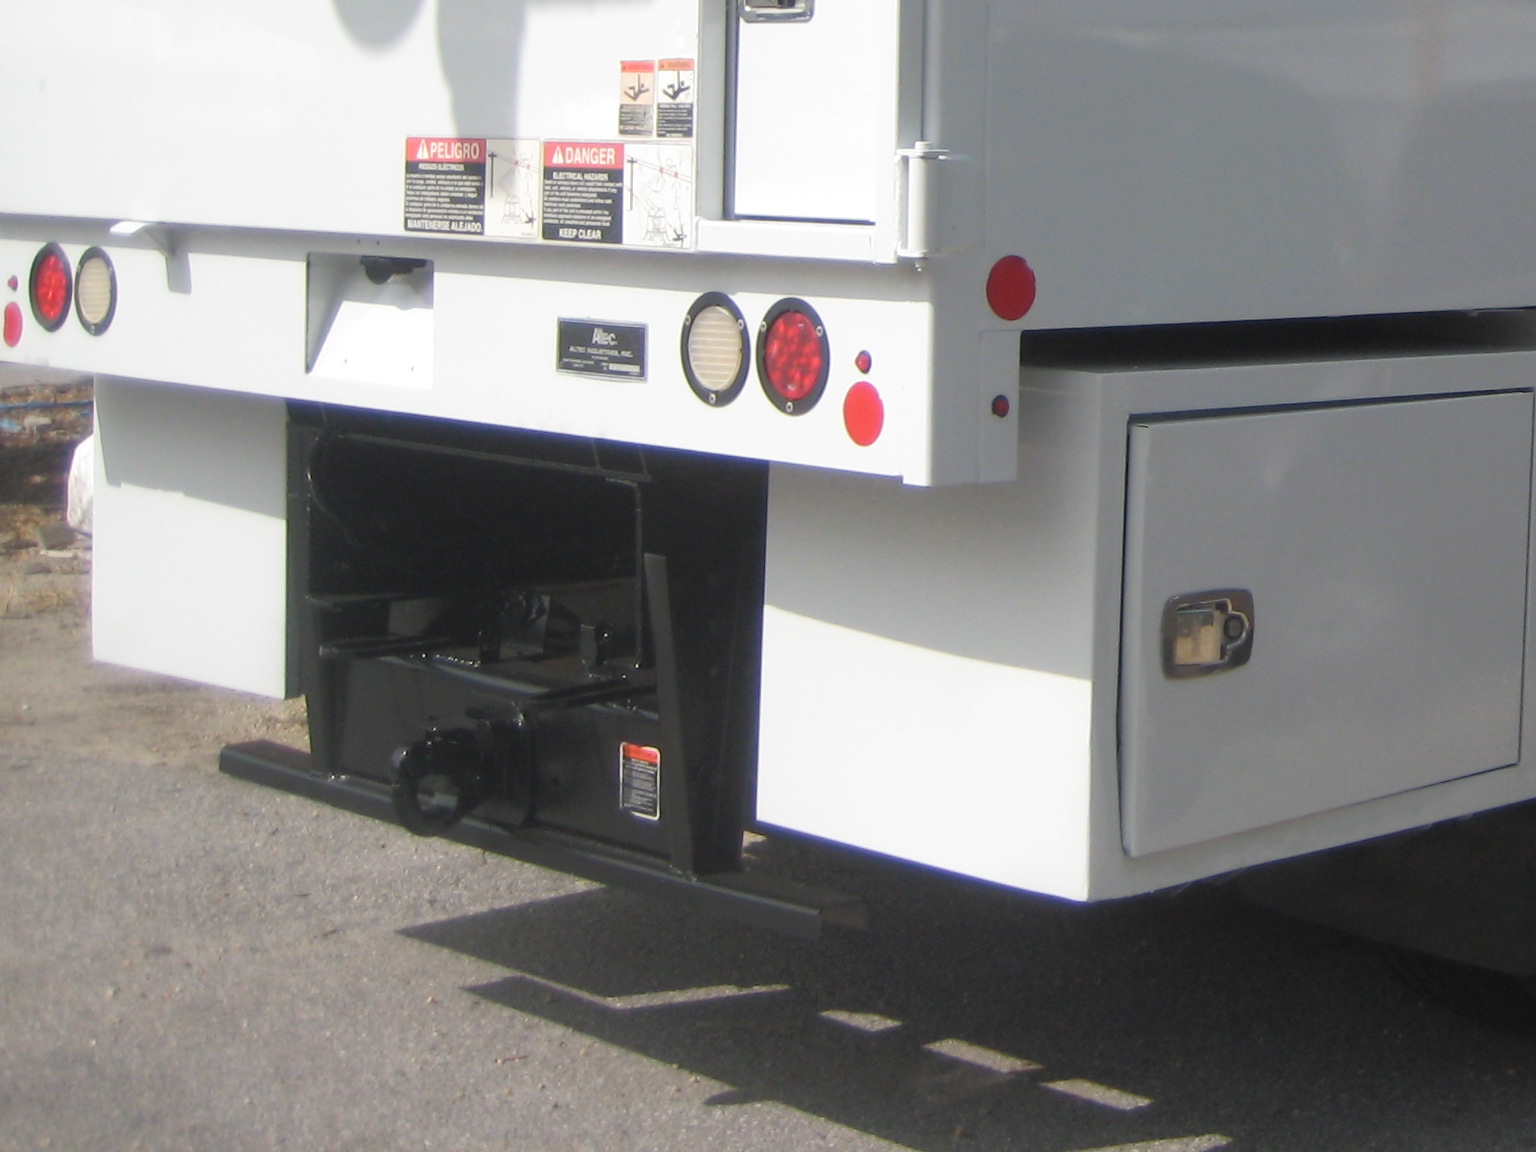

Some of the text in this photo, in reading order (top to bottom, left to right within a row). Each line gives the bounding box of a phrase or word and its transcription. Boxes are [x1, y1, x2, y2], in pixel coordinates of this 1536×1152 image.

[430, 141, 480, 160] PELIGRO
[565, 147, 616, 165] DANGER
[407, 219, 450, 231] MANTENERSE
[559, 228, 602, 240] KEEP CLEAR
